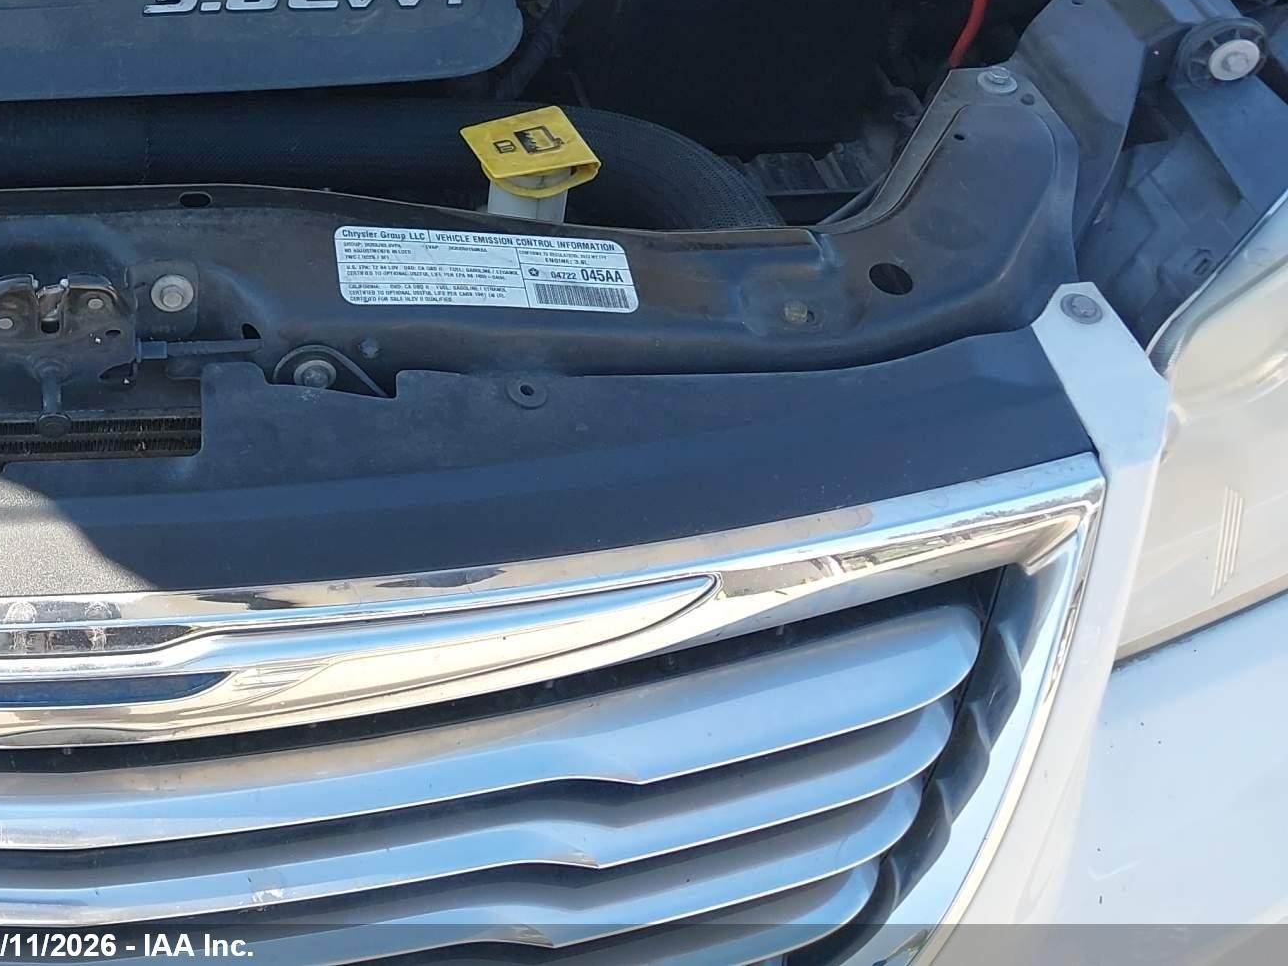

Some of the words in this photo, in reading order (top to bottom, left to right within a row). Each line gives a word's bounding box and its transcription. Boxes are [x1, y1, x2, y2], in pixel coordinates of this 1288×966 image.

[342, 229, 378, 239] Chrysler
[380, 230, 406, 241] Group
[409, 232, 426, 241] LLC
[435, 233, 471, 243] VEHICLE
[473, 235, 514, 246] EMISSION
[515, 238, 556, 248] CONTROL
[556, 240, 615, 251] INFORMATION
[550, 270, 577, 280] 04722
[580, 268, 624, 283] 045AA
